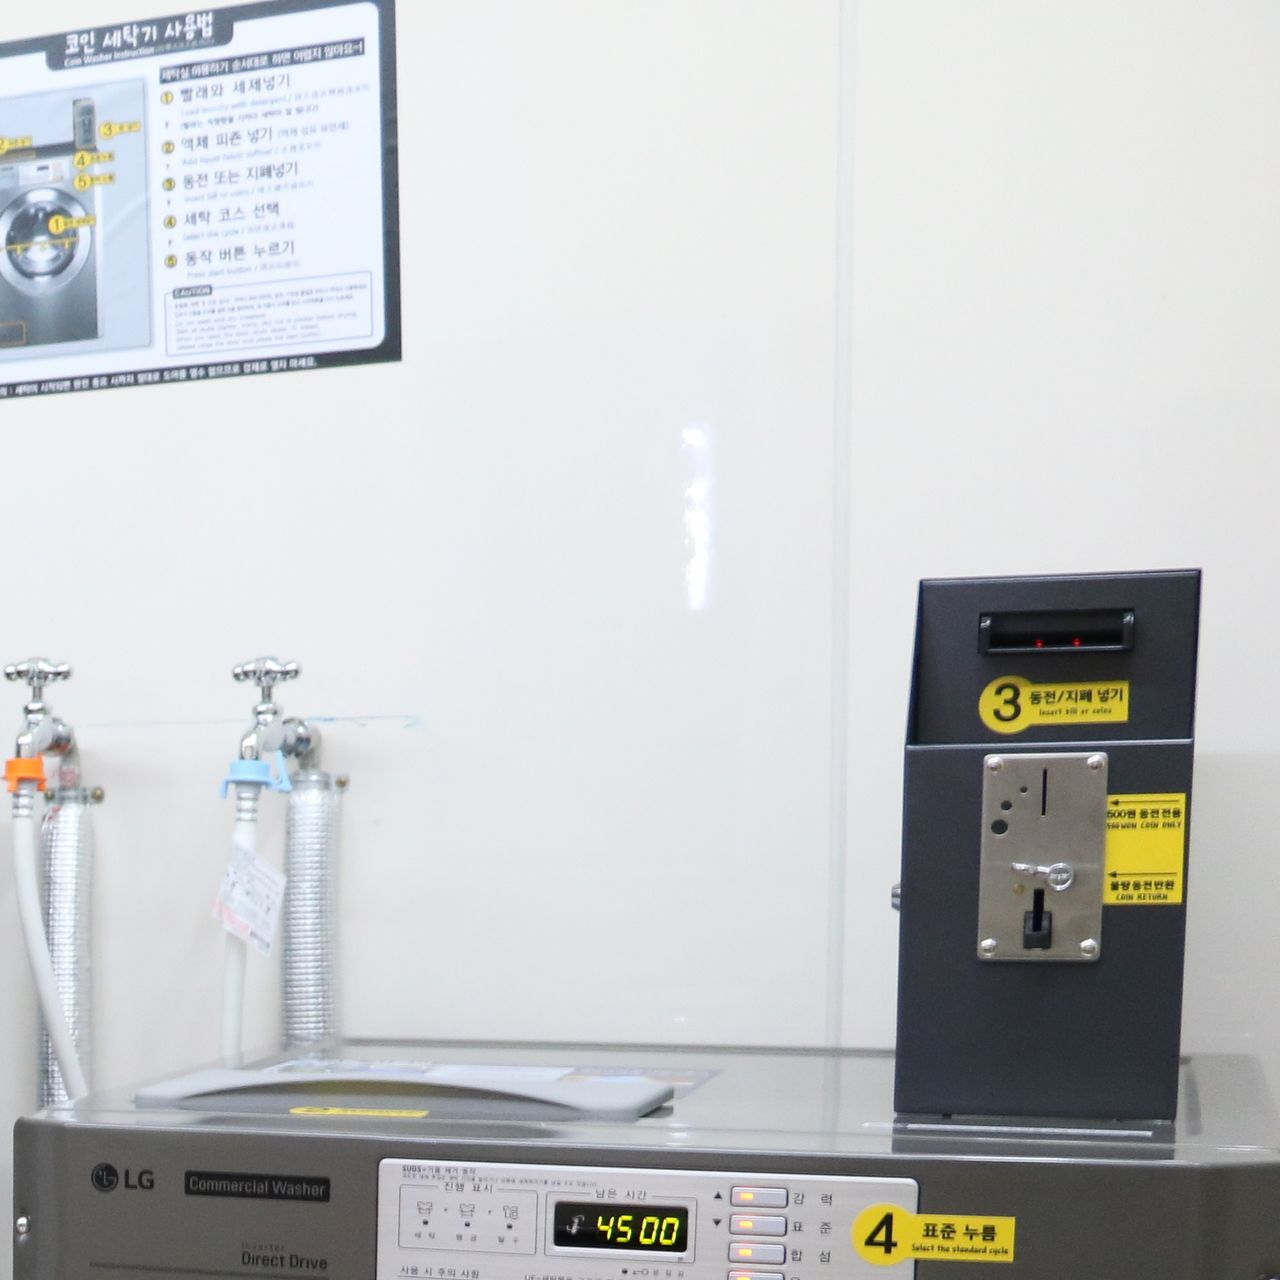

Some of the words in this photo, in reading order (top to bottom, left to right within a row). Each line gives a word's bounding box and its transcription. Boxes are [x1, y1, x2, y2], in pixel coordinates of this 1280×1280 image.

[65, 31, 94, 55] 코인
[103, 24, 157, 48] 세탁기
[165, 12, 213, 40] 사용법
[181, 83, 224, 102] 빨래와
[234, 74, 290, 94] 세제넣기
[248, 127, 273, 142] 넣기
[183, 173, 208, 190] 동전
[214, 170, 240, 185] 또는
[247, 162, 298, 180] 지폐넣기
[185, 209, 210, 225] 세탁
[219, 207, 245, 222] 코스
[254, 202, 279, 219] 선택
[186, 251, 212, 267] 동작
[220, 247, 245, 261] 버튼
[254, 240, 295, 259] 누르기
[174, 287, 210, 298] CAUTION
[994, 683, 1021, 721] 3
[1030, 689, 1092, 705] 동전/지폐
[1098, 688, 1123, 703] 넣기
[125, 1168, 154, 1190] LG
[190, 1176, 268, 1193] Commercial
[272, 1178, 326, 1196] Washer
[626, 1189, 647, 1200] 시간
[597, 1215, 679, 1245] 4500
[864, 1212, 897, 1254] 4
[922, 1225, 957, 1239] 표준
[963, 1224, 997, 1241] 누름
[242, 1251, 284, 1267] Direct
[290, 1254, 327, 1270] Drive
[912, 1243, 934, 1253] Select
[937, 1244, 949, 1253] the
[953, 1245, 987, 1255] standard
[990, 1247, 1008, 1255] cycle
